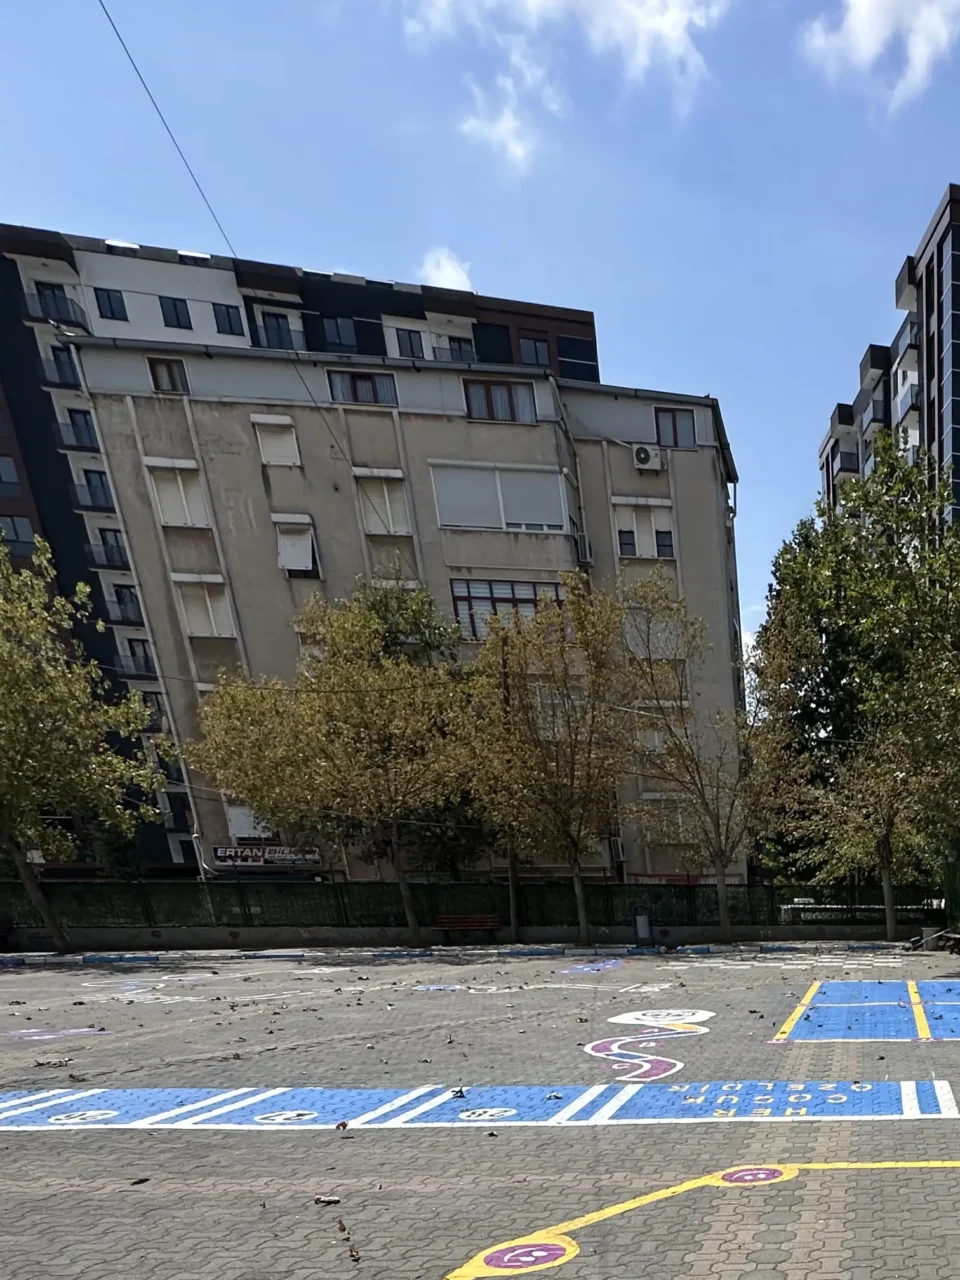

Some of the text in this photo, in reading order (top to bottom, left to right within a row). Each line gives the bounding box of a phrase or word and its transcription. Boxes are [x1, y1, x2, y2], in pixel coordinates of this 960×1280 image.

[217, 848, 263, 857] ERTAN
[712, 1107, 807, 1117] HER
[258, 1113, 315, 1122] 27
